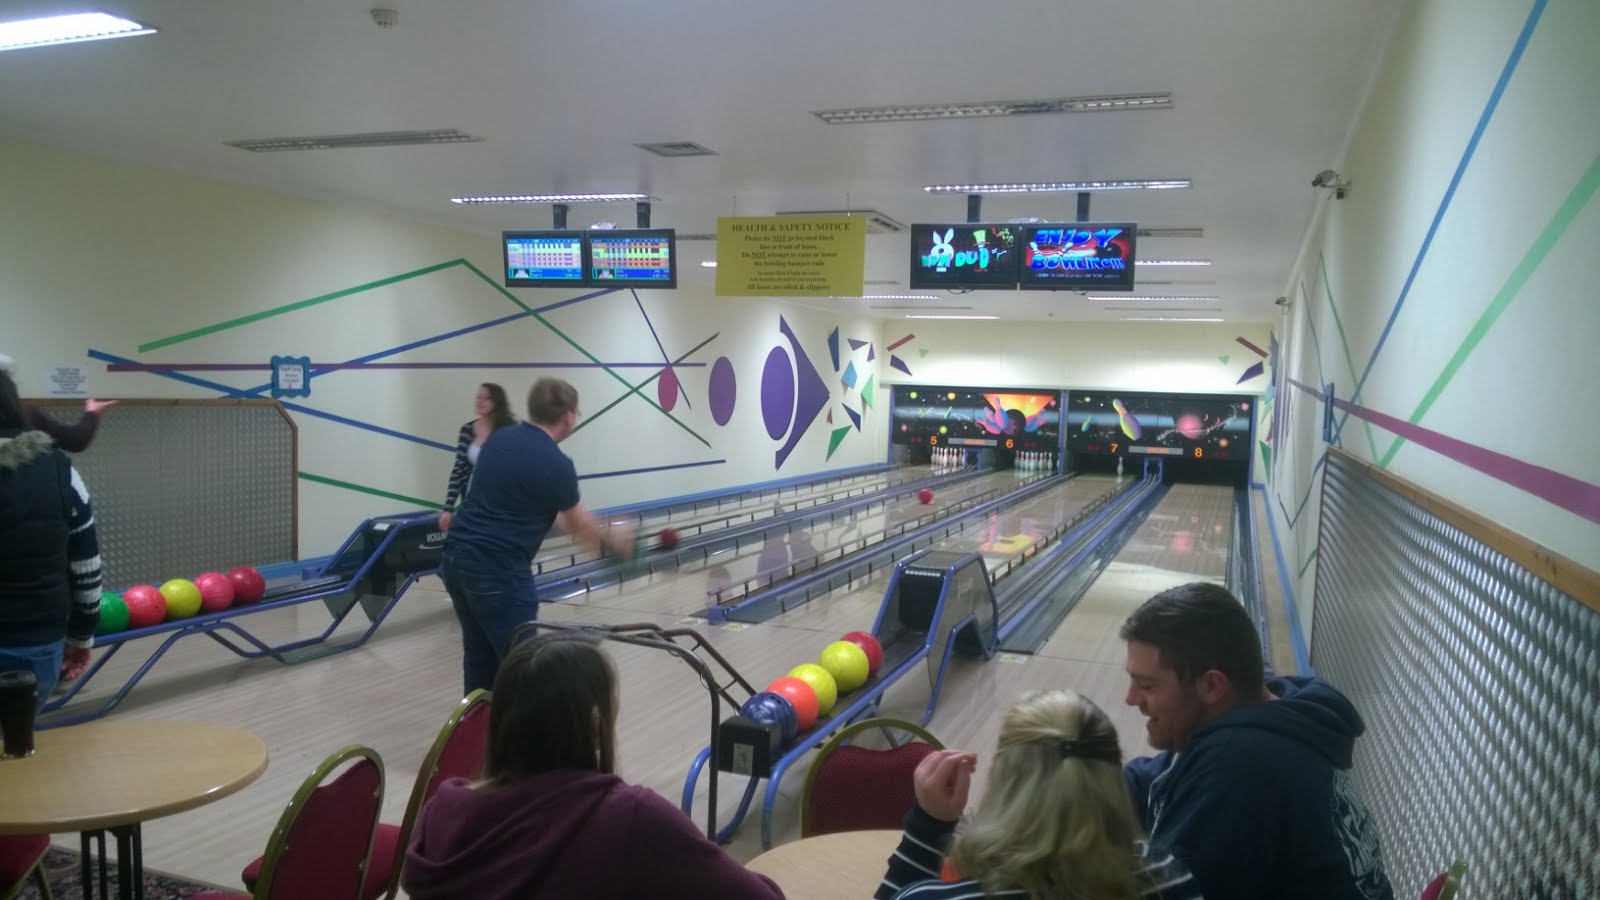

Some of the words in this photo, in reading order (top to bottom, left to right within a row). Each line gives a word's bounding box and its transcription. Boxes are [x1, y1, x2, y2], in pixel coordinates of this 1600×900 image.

[732, 223, 768, 233] HEALTH
[769, 223, 777, 232] &
[778, 223, 812, 232] SAFETY
[815, 223, 849, 231] NOTICE
[744, 234, 762, 242] Please
[771, 234, 786, 242] NOT
[795, 234, 818, 242] beyond
[1034, 228, 1123, 248] ENJOY
[751, 251, 766, 260] NOT
[767, 251, 790, 260] attempt
[763, 260, 787, 268] bowling
[787, 260, 811, 269] bumper
[806, 283, 831, 292] slippery
[930, 435, 938, 445] 5
[1005, 438, 1014, 448] 6
[1110, 443, 1119, 453] 7
[1194, 447, 1203, 458] 8
